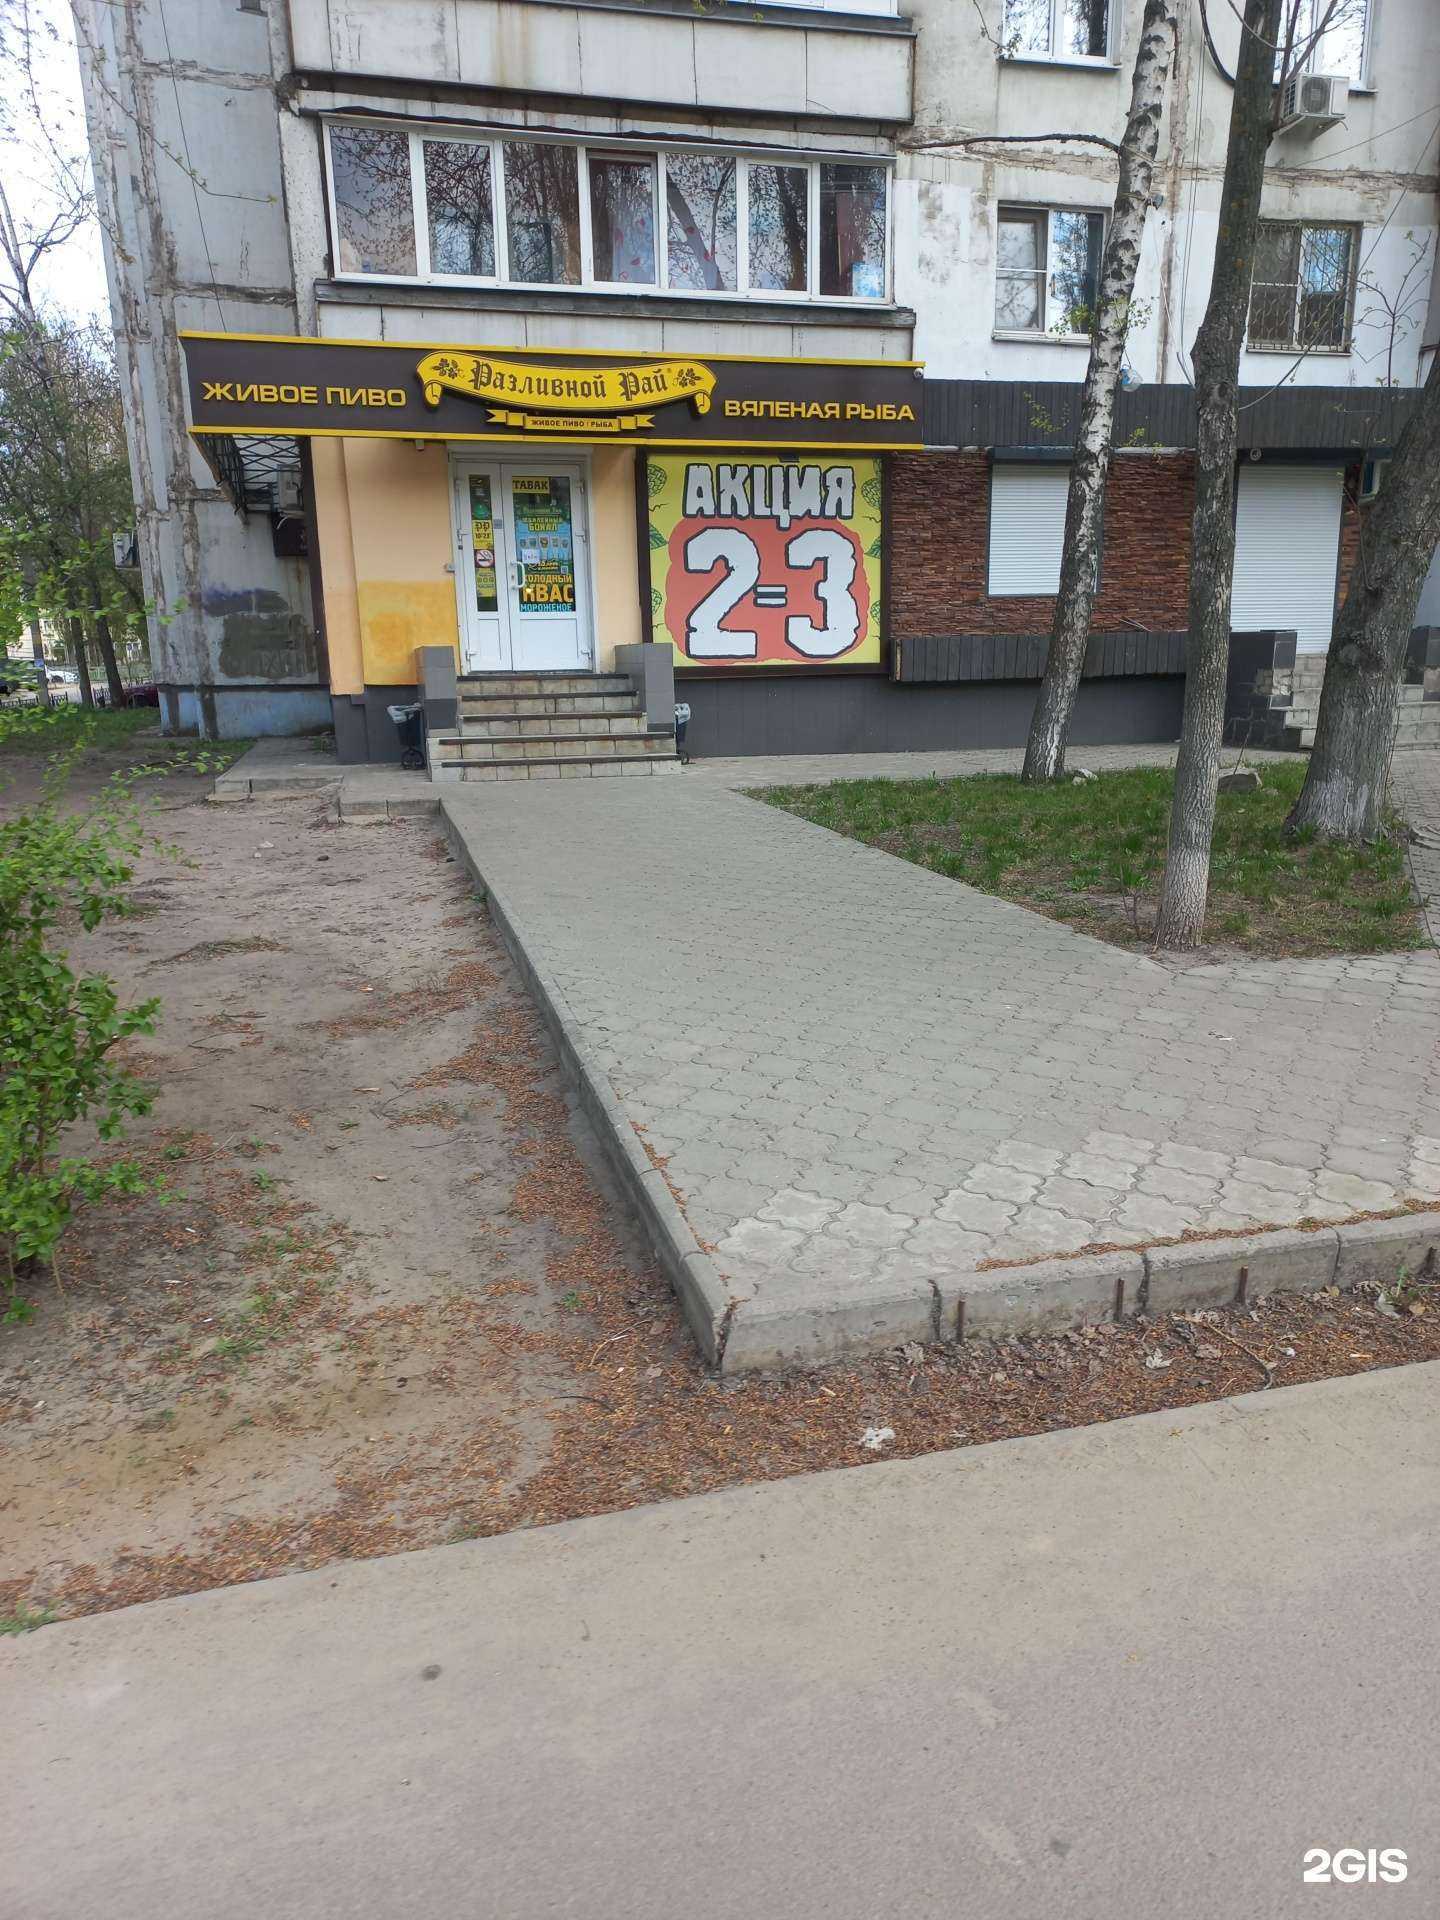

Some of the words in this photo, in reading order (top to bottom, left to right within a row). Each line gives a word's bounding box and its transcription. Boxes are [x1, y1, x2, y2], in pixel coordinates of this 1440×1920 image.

[470, 360, 607, 399] Разливной
[618, 370, 668, 401] Рай
[201, 381, 318, 405] ЖИВОЕ
[325, 386, 407, 408] ПИВО
[724, 399, 841, 419] ВЯЛЕНАЯ
[845, 403, 915, 421] РЫБА
[531, 419, 560, 427] ЖИВОЕ
[682, 463, 855, 531] АКЦИЯ
[522, 583, 574, 602] КВАС
[520, 603, 572, 612] МОРОЖЕНОЕ
